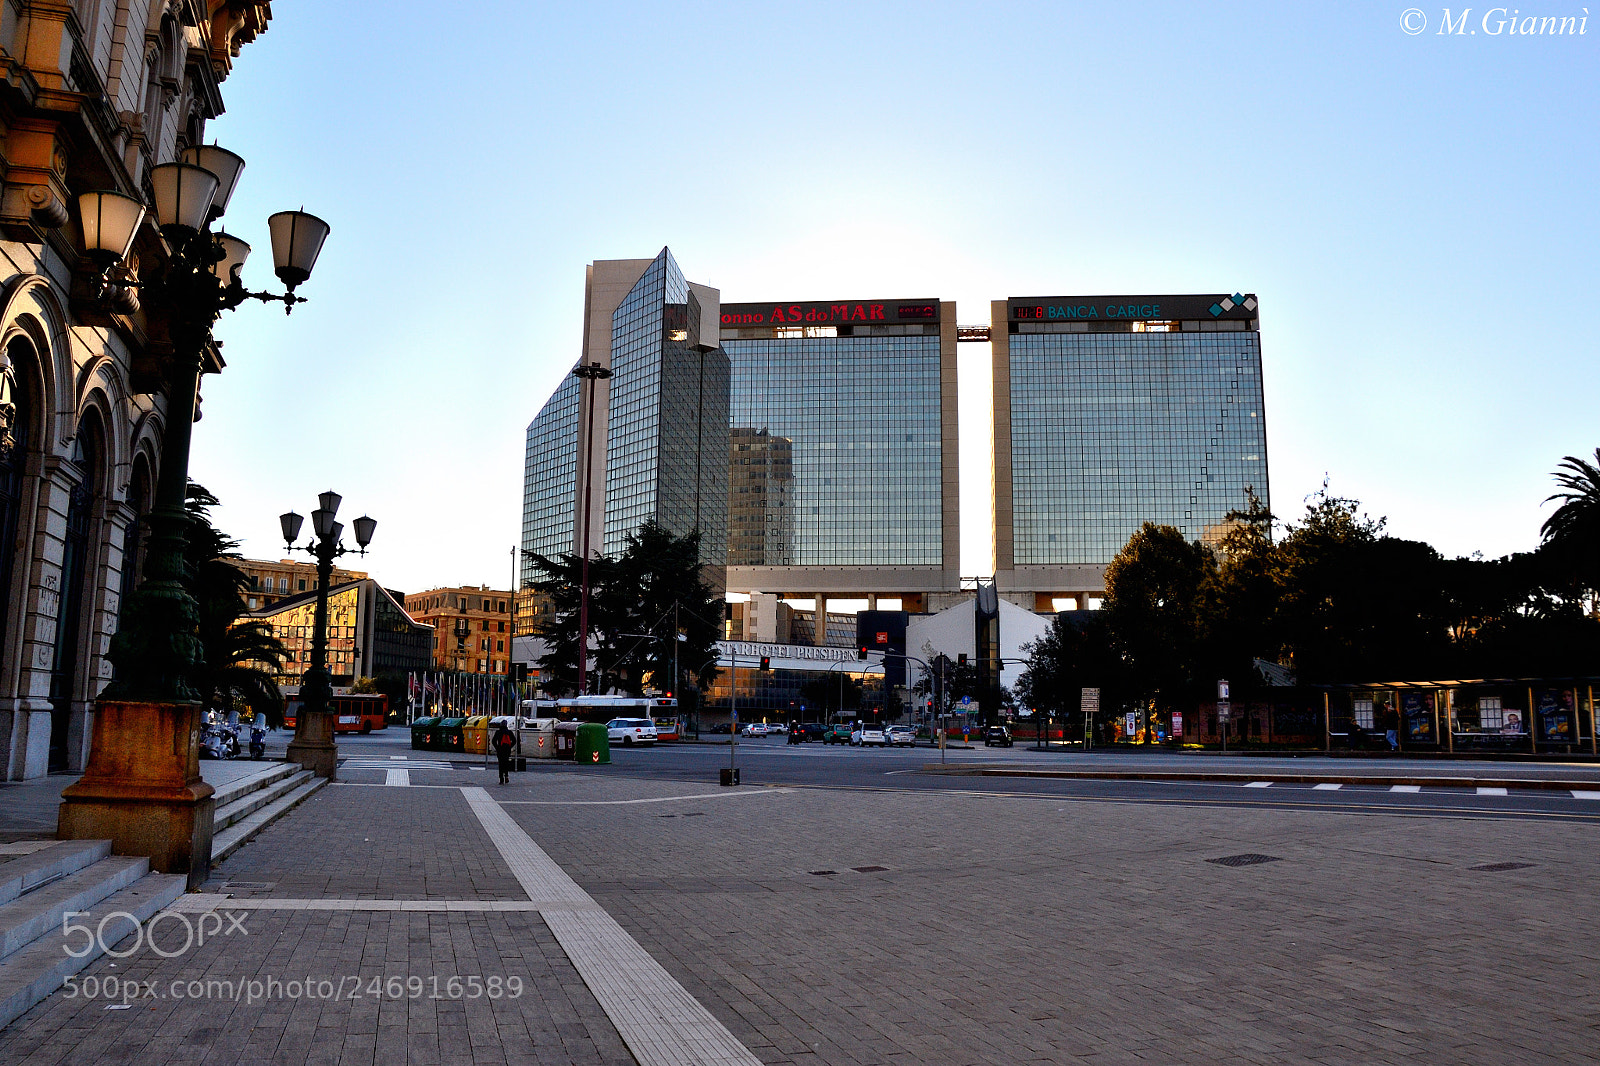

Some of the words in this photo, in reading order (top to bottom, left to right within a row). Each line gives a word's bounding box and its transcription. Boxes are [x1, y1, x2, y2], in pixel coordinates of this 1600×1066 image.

[718, 311, 764, 324] onno
[1047, 305, 1099, 319] BANCA
[1105, 304, 1161, 318] CARIGE
[716, 641, 792, 658] STARHOTEL
[796, 646, 861, 662] PRESIDEN
